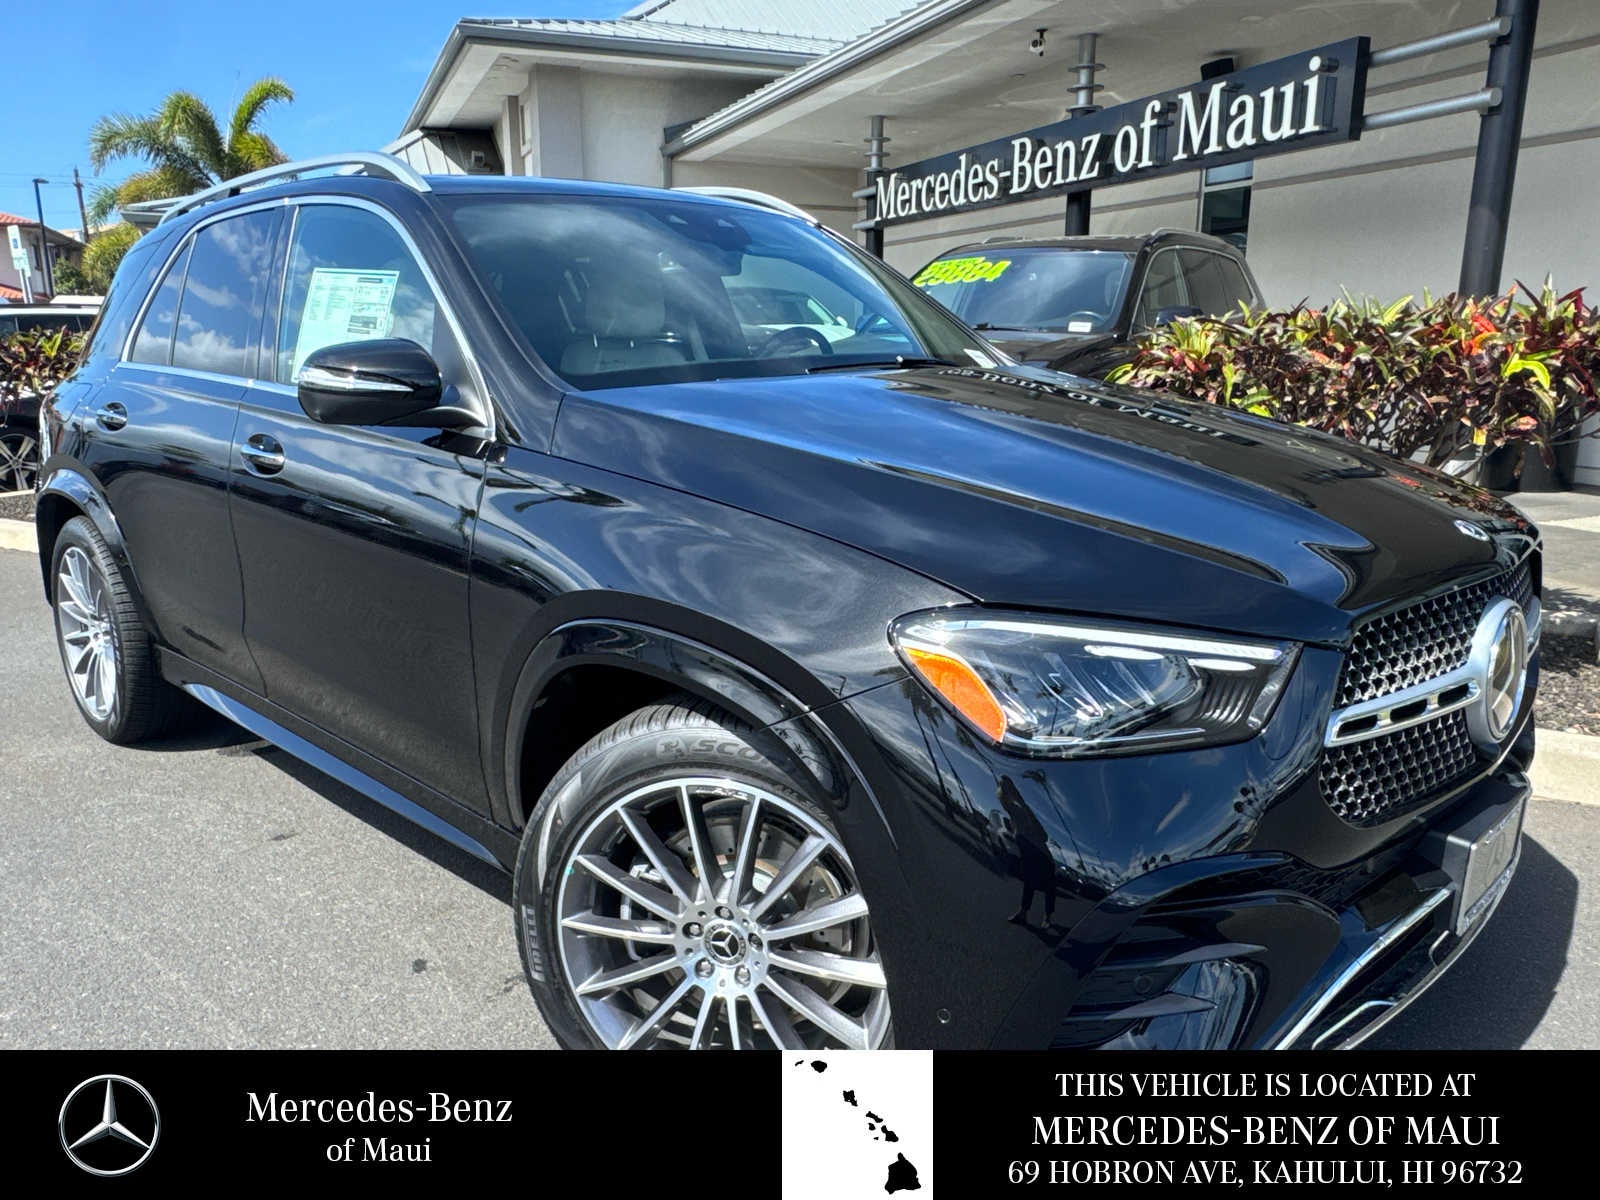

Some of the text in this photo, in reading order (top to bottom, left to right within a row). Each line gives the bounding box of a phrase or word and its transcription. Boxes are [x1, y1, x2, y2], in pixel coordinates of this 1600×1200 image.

[873, 55, 1321, 222] Mercedes-Benz of Maui
